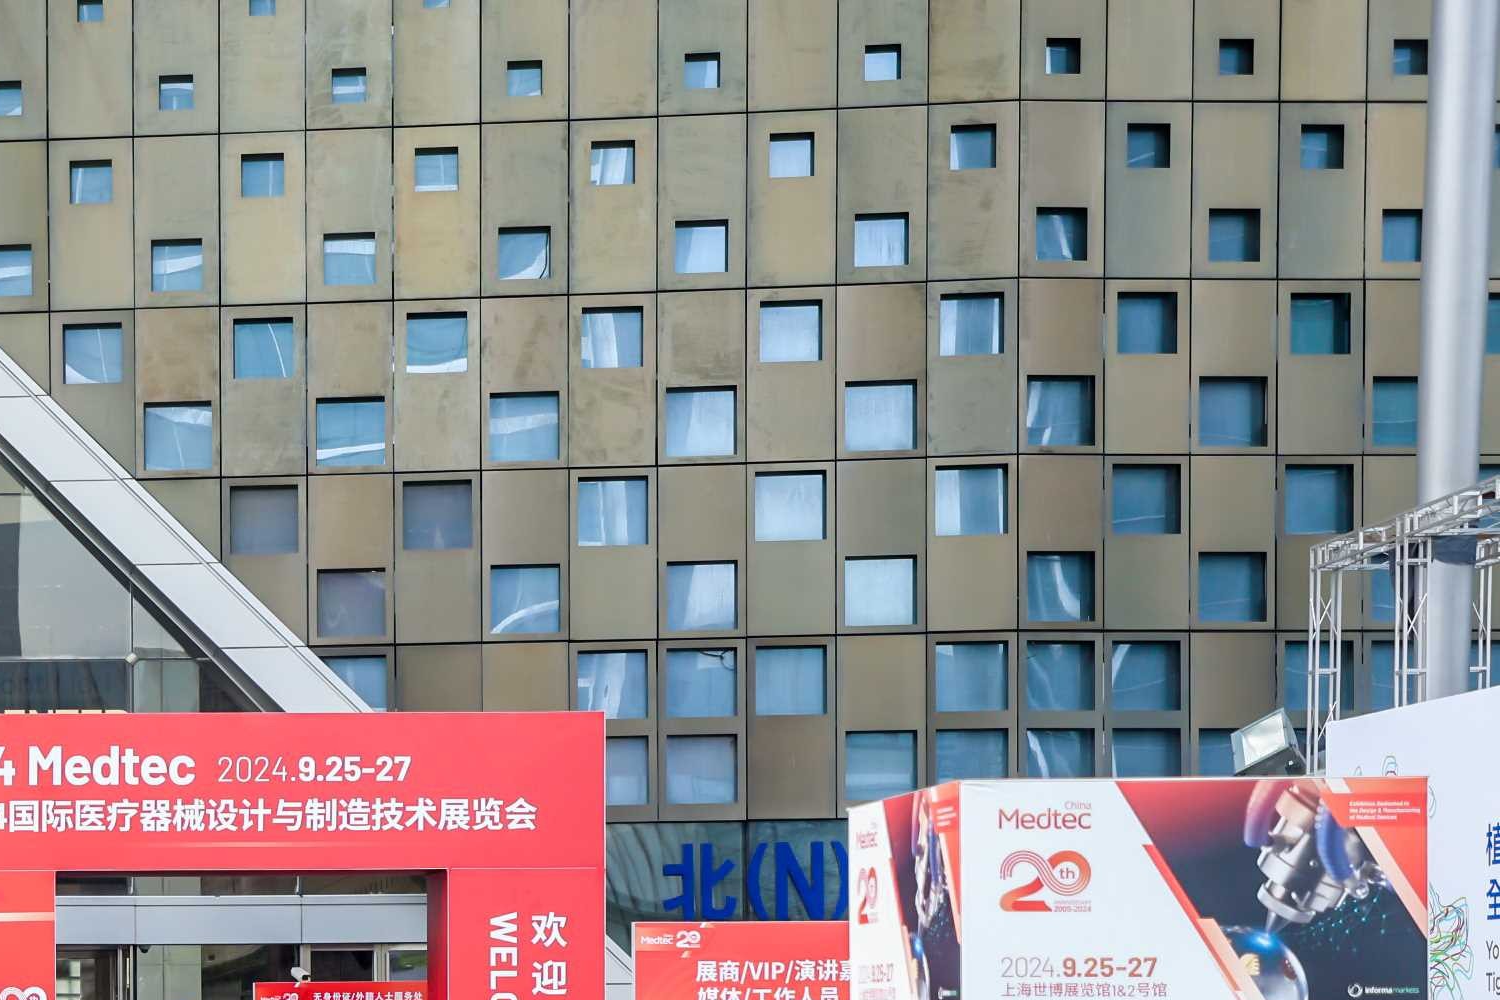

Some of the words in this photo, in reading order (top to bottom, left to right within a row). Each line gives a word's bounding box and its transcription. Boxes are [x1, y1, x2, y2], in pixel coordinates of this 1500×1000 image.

[28, 745, 196, 786] Medtec
[217, 755, 412, 783] 2024.9.25-27
[1064, 800, 1092, 810] China
[998, 808, 1092, 830] Medtec
[1001, 956, 1158, 978] 2024.9.25-27
[1001, 982, 1167, 998] 上海世博展览馆1&2号馆
